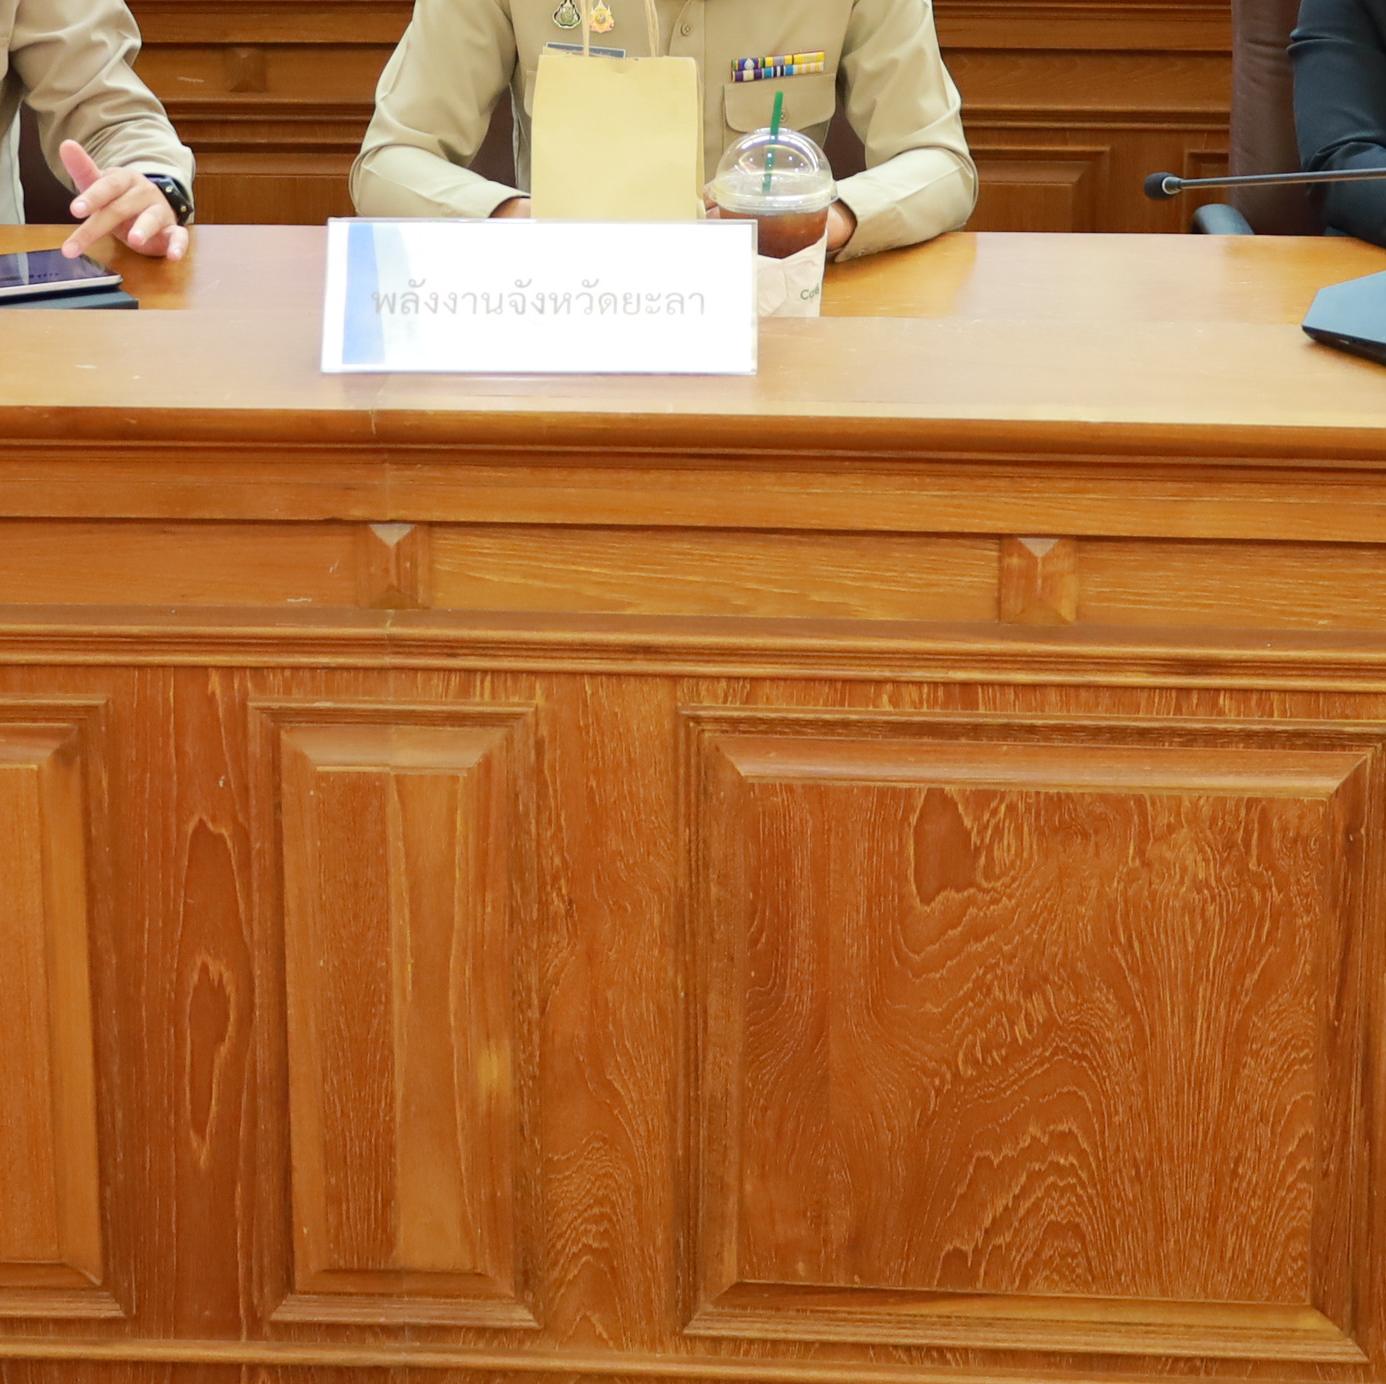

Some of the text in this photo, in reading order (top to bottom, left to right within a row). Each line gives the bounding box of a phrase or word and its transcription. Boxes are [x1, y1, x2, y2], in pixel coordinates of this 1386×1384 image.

[370, 278, 706, 317] พลังงานจังหวัดยะลา
